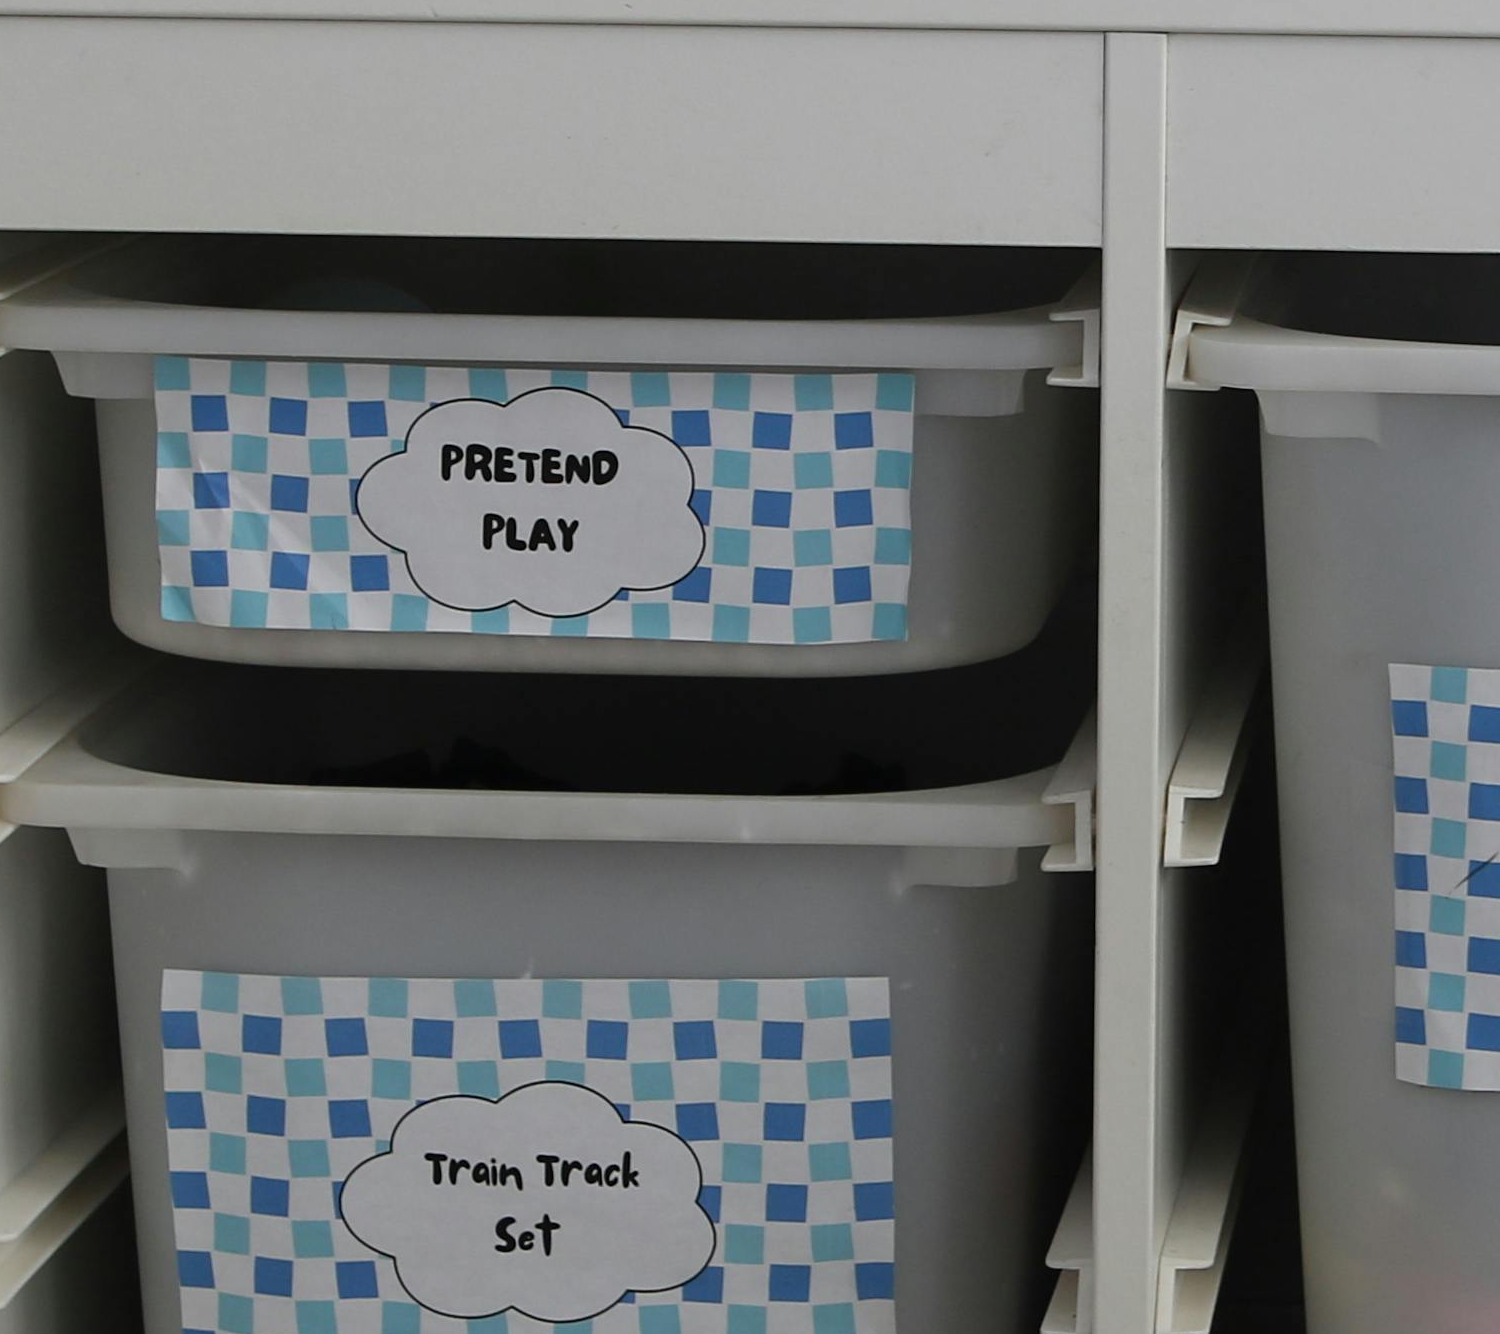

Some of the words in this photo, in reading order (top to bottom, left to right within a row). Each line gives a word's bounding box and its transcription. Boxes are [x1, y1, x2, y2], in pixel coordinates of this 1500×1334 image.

[441, 443, 619, 485] PRETEND
[482, 513, 579, 552] PLAY
[424, 1152, 523, 1191] Train
[536, 1151, 640, 1189] Track
[495, 1214, 561, 1256] Set
